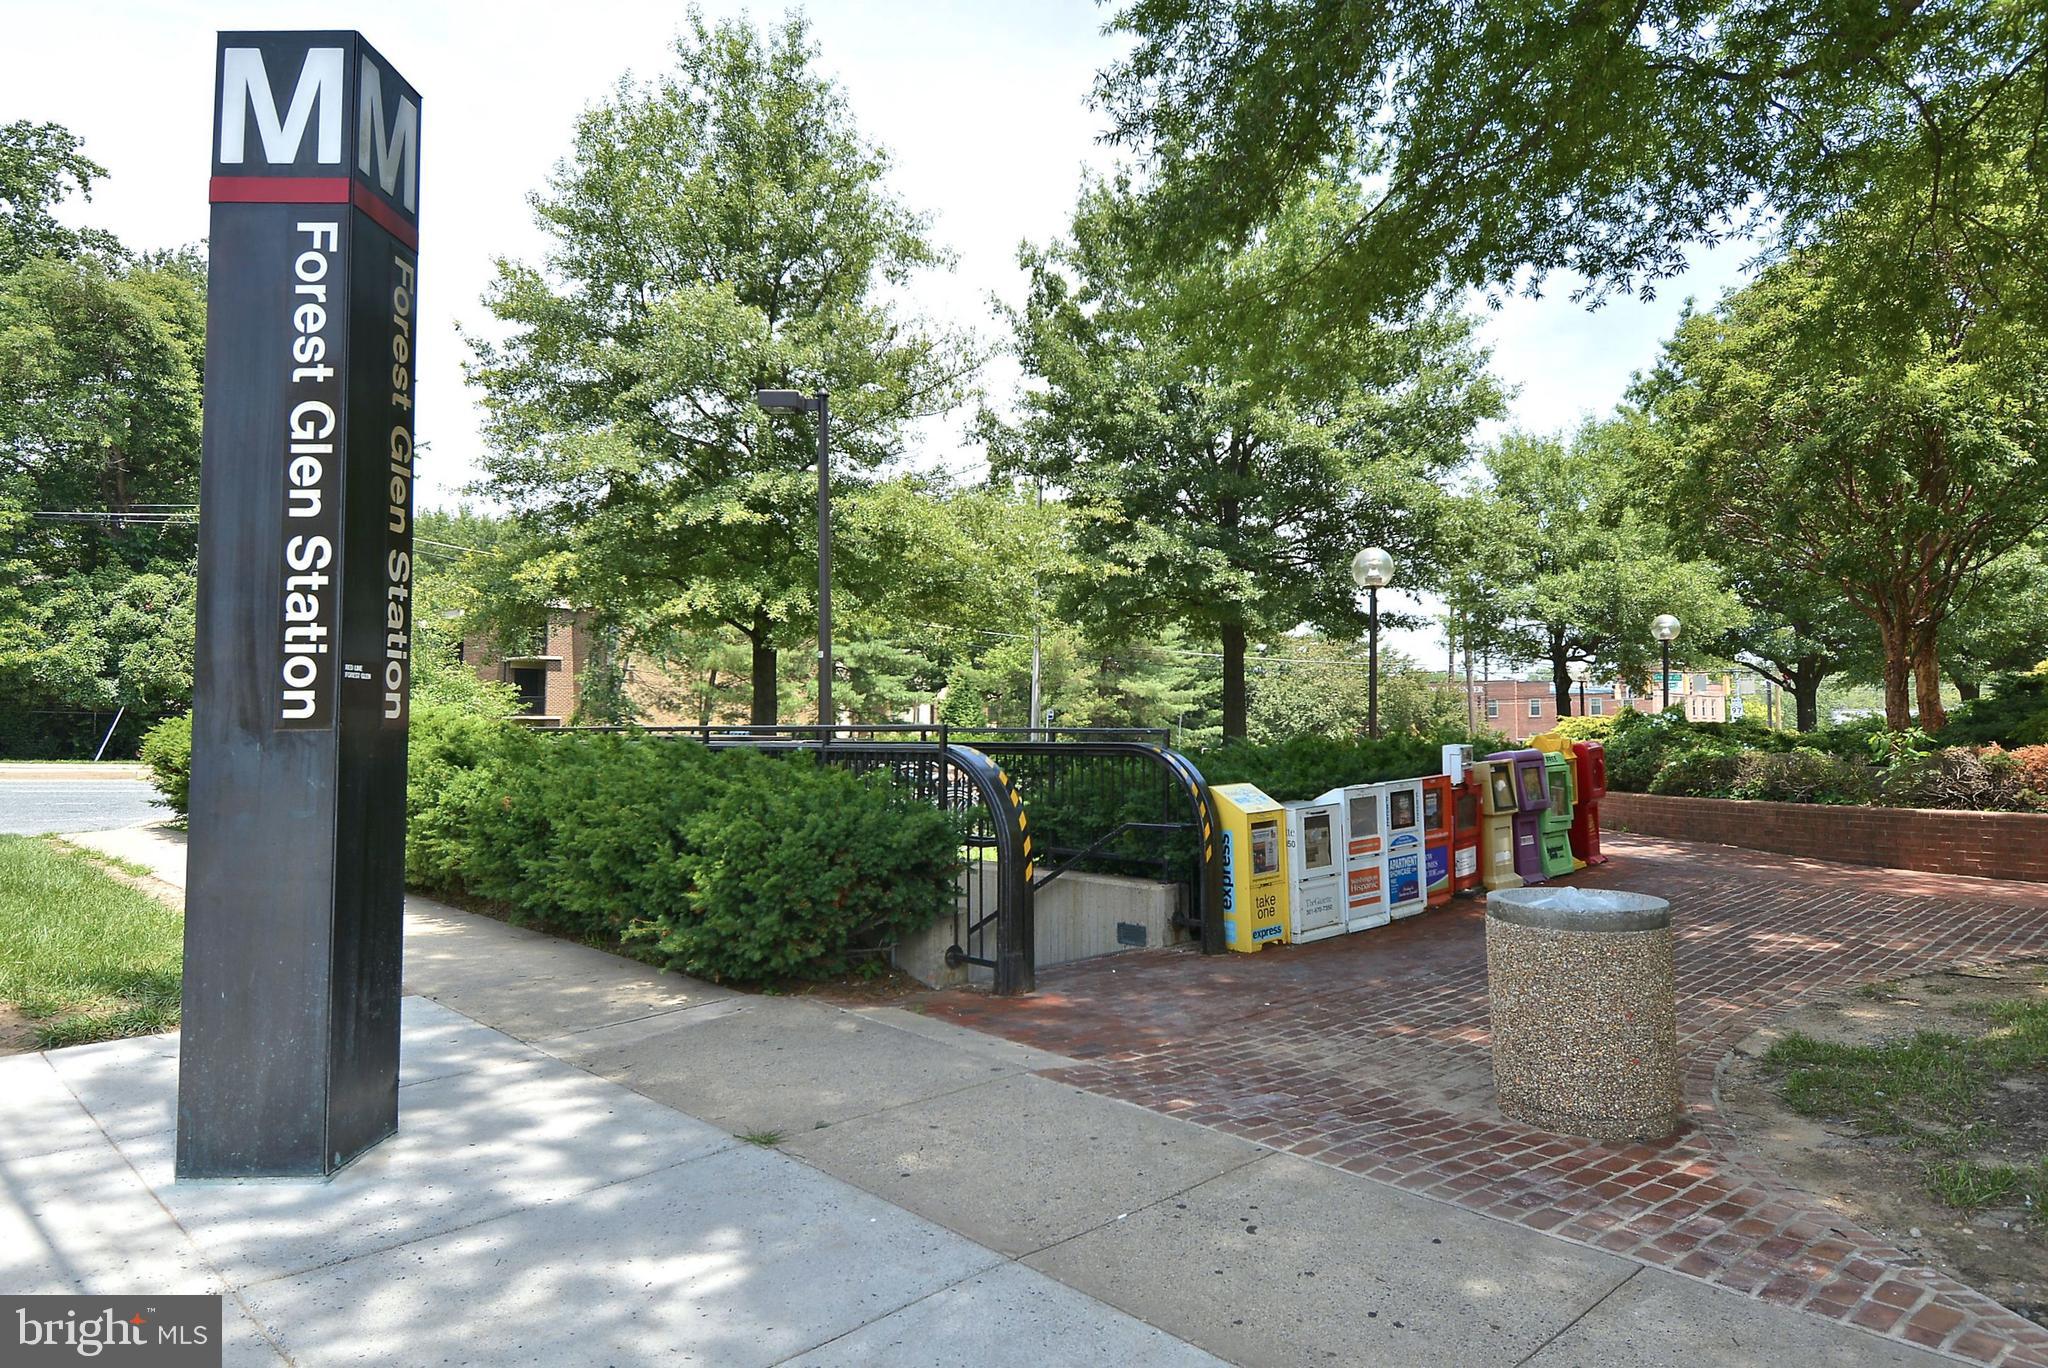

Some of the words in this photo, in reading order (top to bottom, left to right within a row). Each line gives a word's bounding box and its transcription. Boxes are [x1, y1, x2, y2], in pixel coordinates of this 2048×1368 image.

[220, 47, 344, 165] M
[358, 53, 418, 215] M
[292, 222, 338, 384] Forest
[392, 255, 414, 411] Forest
[288, 400, 336, 518] Glen
[388, 425, 413, 534] Glen
[282, 534, 333, 720] Station
[384, 548, 411, 720] Station
[1252, 924, 1282, 941] express
[1255, 893, 1276, 909] take
[1257, 905, 1276, 920] one
